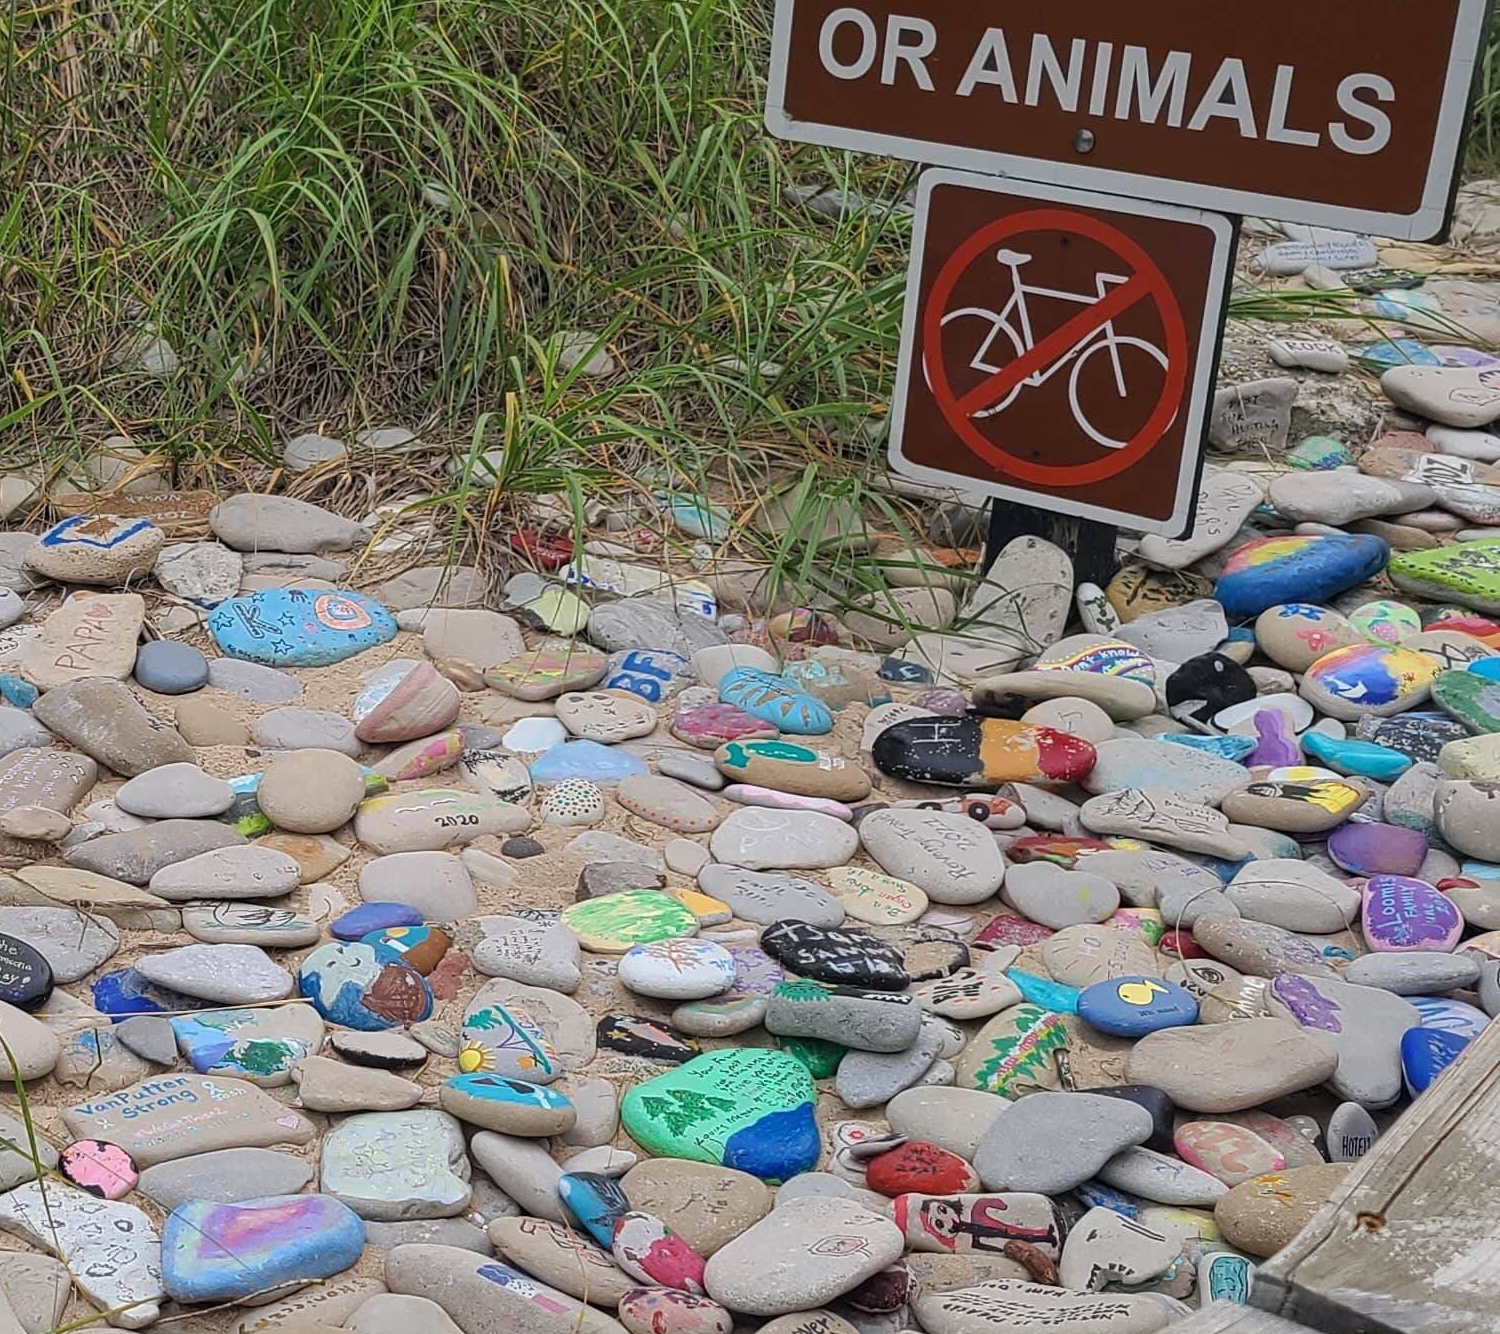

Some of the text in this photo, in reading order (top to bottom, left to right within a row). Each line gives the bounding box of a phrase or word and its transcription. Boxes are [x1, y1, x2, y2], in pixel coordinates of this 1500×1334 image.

[817, 6, 1397, 158] OR ANIMALS
[1284, 340, 1341, 356] ROCK
[54, 619, 118, 670] PAPA
[434, 814, 480, 829] 2020
[75, 1075, 192, 1116] VanPutten
[122, 1088, 199, 1120] Strong
